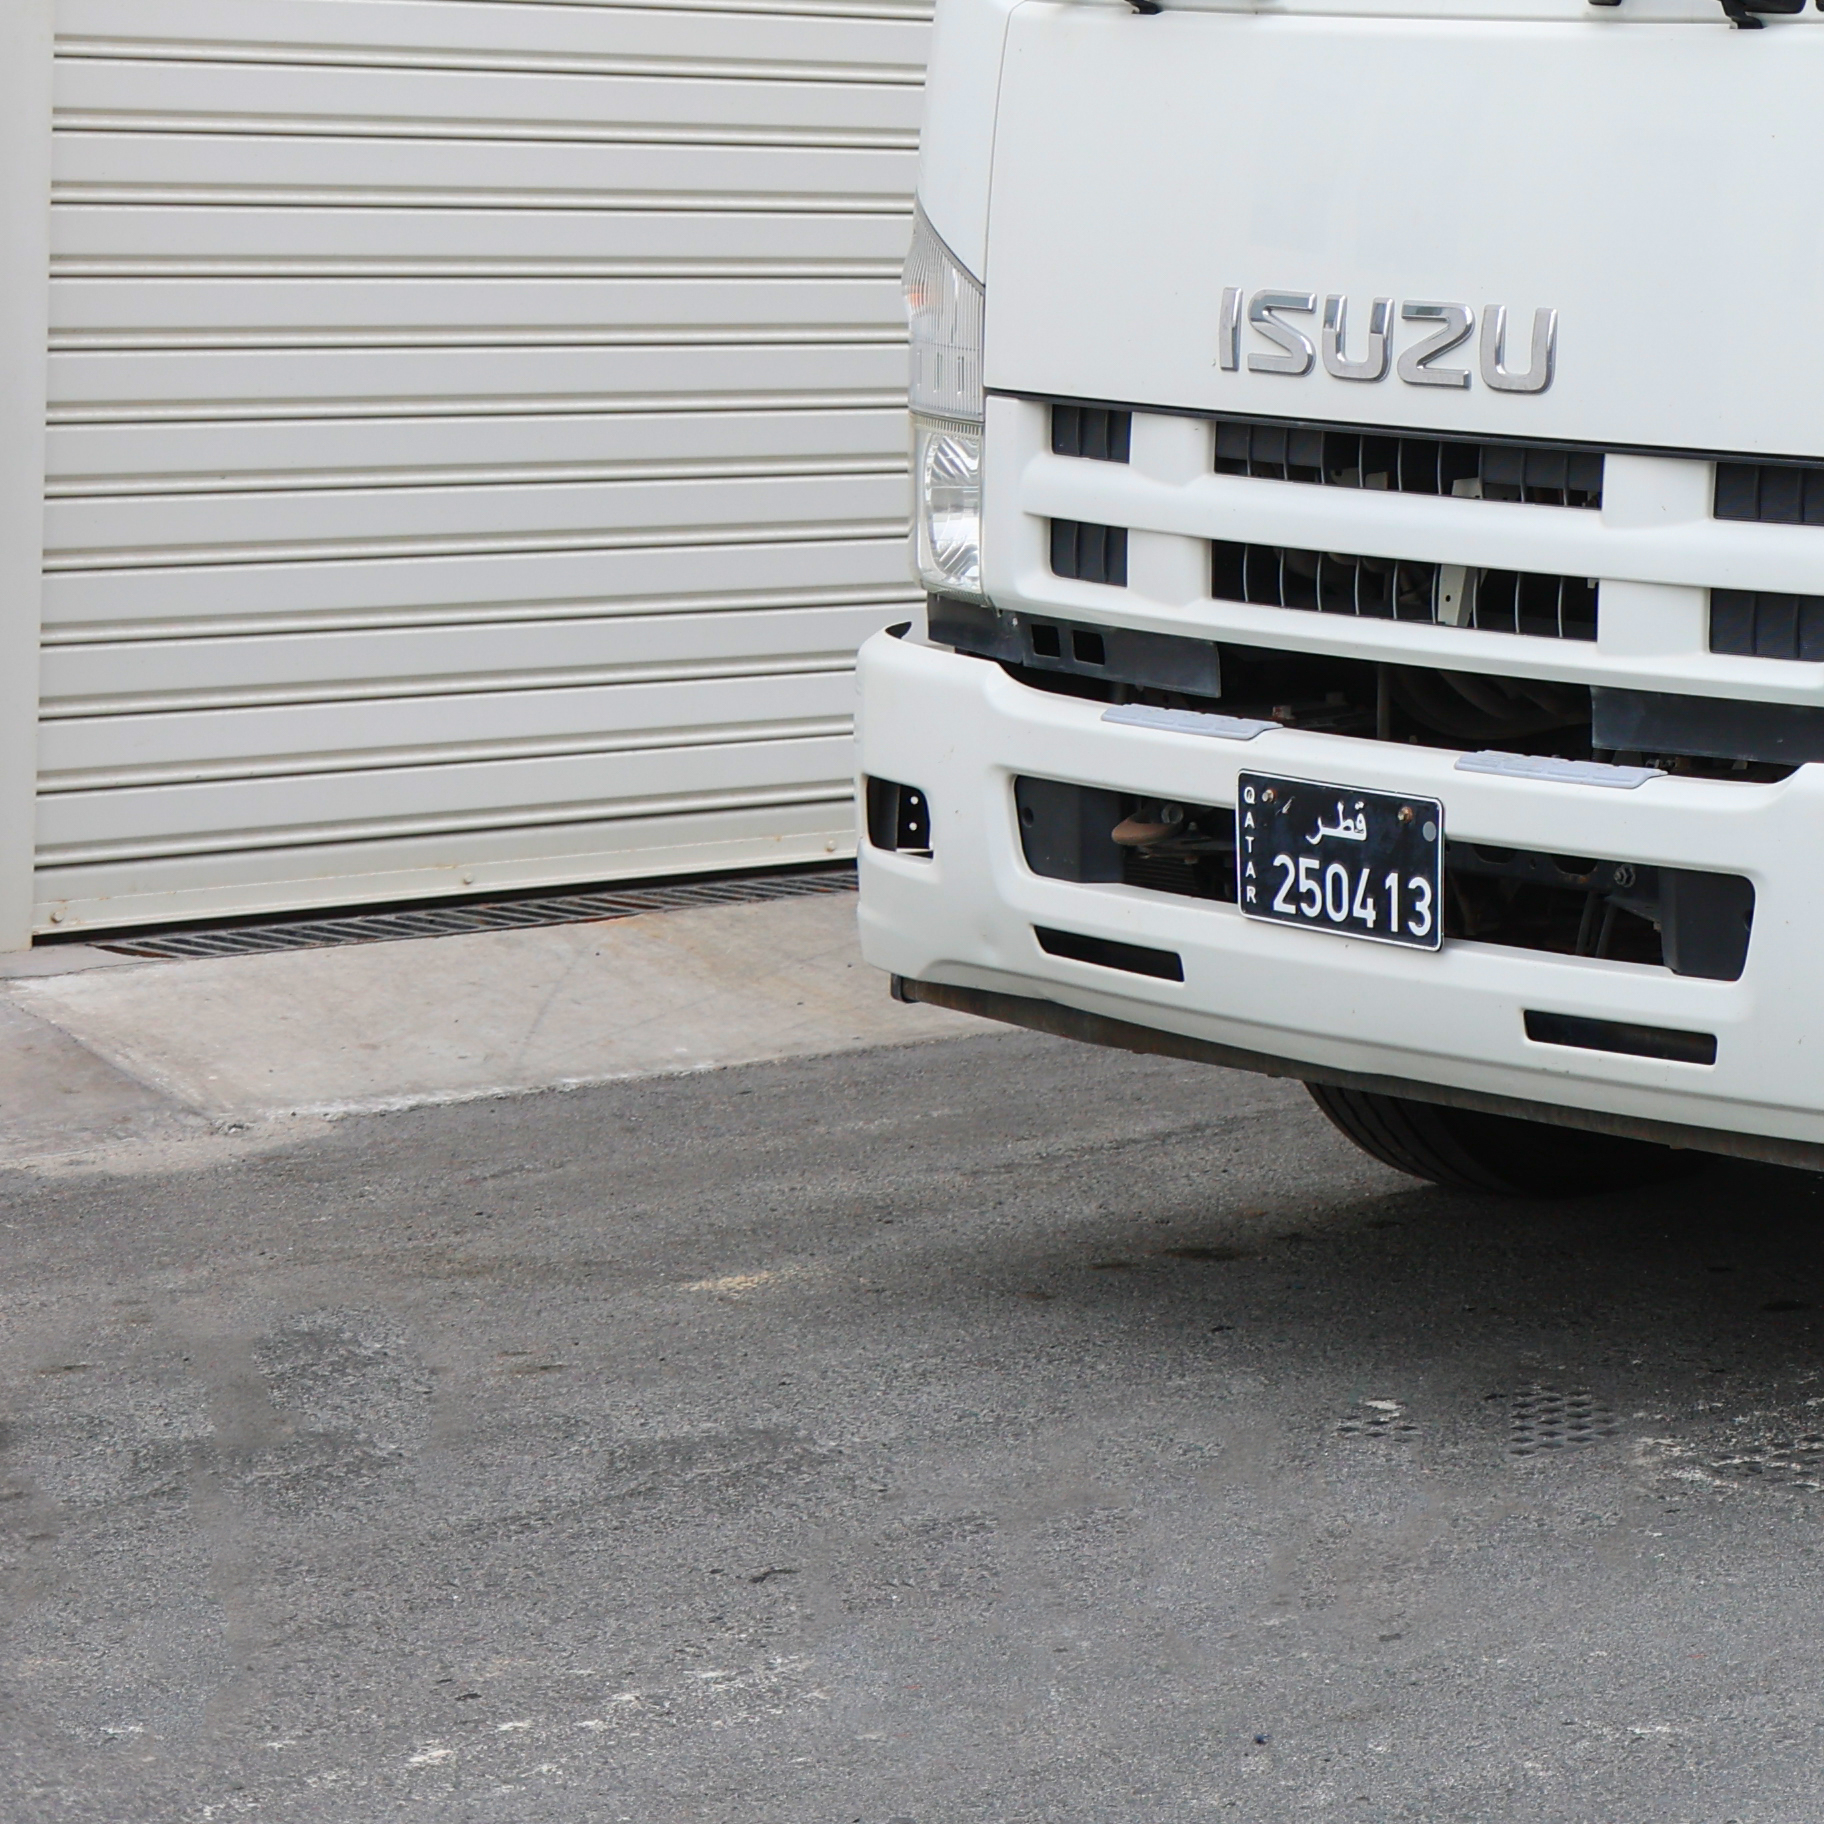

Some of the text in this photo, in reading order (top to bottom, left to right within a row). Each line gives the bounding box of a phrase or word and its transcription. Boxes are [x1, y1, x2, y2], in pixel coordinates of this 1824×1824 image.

[1219, 286, 1559, 396] ISUZU
[1243, 786, 1257, 905] QATAR
[1304, 800, 1367, 845] قطر
[1272, 853, 1433, 937] 250413
